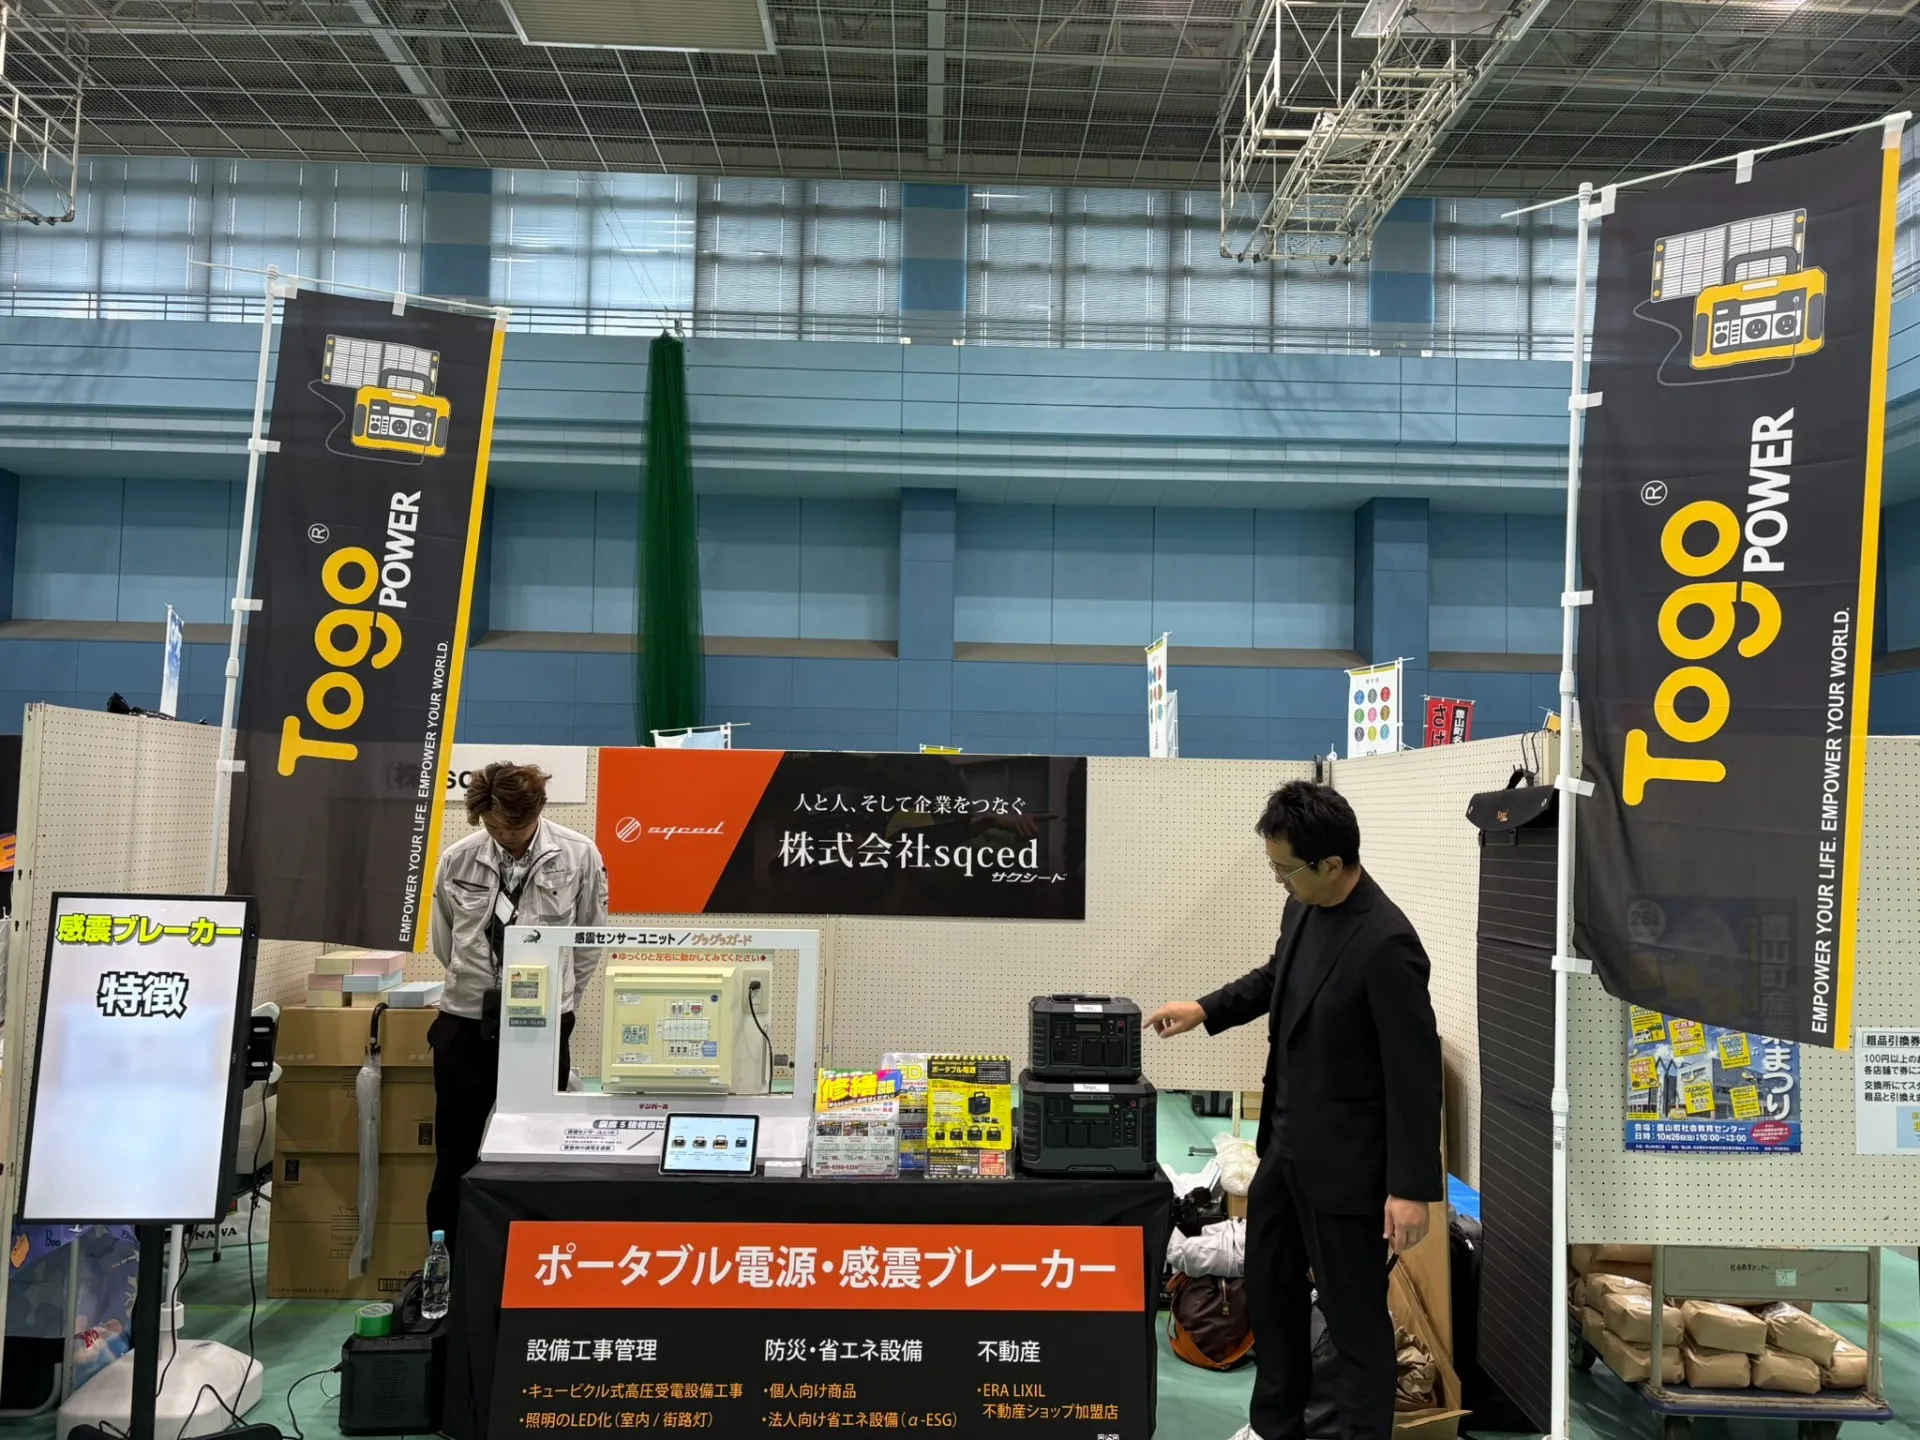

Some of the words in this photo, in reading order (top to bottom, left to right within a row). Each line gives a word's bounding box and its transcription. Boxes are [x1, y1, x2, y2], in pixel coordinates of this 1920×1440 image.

[1743, 407, 1794, 572] POWER
[378, 491, 421, 608] POWER
[277, 546, 402, 776] Togo
[432, 641, 449, 689] WORLD.
[1622, 500, 1782, 806] Togo
[1830, 607, 1850, 677] WORLD.
[427, 693, 442, 728] YOUR
[1826, 682, 1845, 733] YOUR
[418, 731, 437, 797] EMPOWER
[1821, 738, 1842, 831] EMPOWER
[413, 802, 428, 831] LIFE.
[793, 793, 1026, 815] 人と人、そして企業をつなぐ
[408, 835, 423, 871] YOUR
[647, 820, 725, 840] sqced
[777, 830, 1038, 877] 株式会社sqced
[991, 871, 1067, 884] サクシード
[1819, 837, 1836, 879] LIFE.
[57, 913, 243, 946] 感震ブレーカー
[399, 874, 418, 942] EMPOWER
[1816, 884, 1834, 935] YOUR
[96, 971, 189, 1019] 特徴
[1811, 940, 1832, 1033] EMPOWER
[534, 1242, 1116, 1289] ポータブル電源・感震ブレーカー
[526, 1338, 657, 1362] 設備工事管理
[764, 1338, 923, 1363] 防災・省エネ設備
[977, 1339, 1041, 1363] 不動産
[982, 1403, 1119, 1420] 不動産ショップ加盟店
[1013, 1383, 1046, 1398] LIXIL
